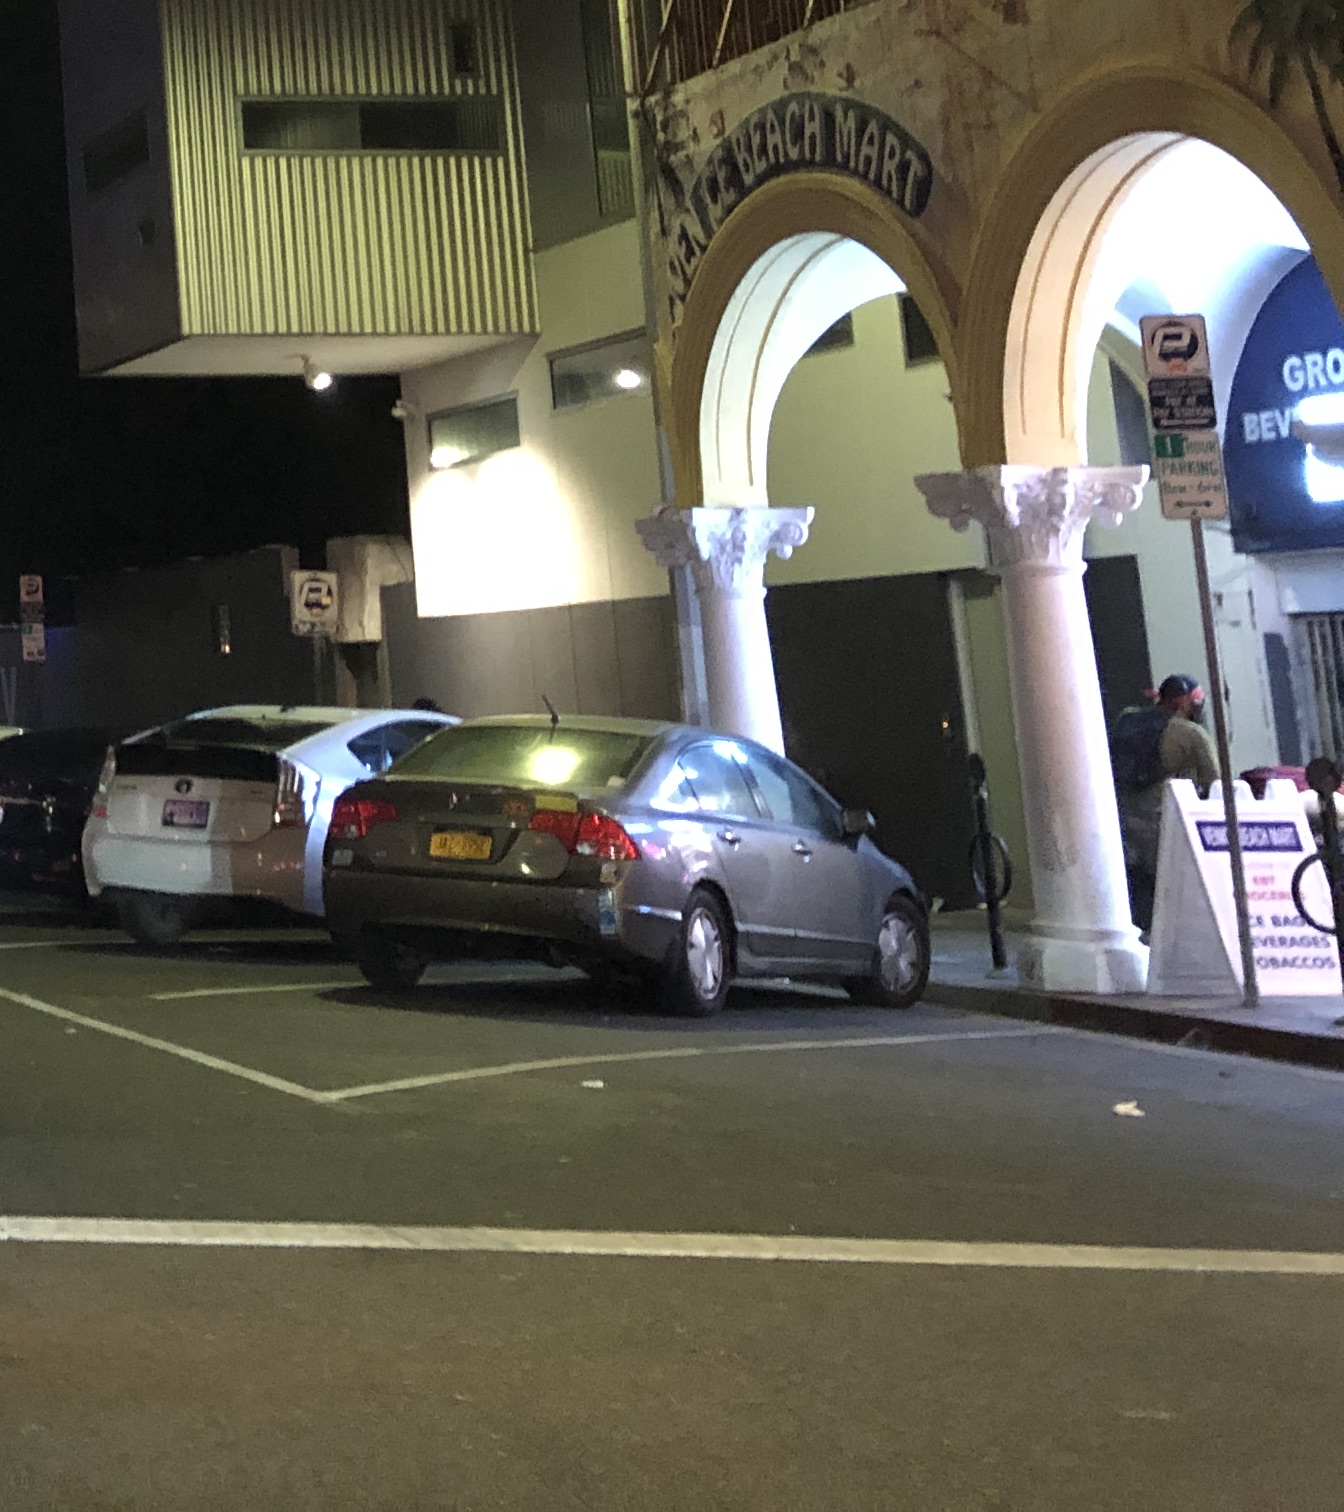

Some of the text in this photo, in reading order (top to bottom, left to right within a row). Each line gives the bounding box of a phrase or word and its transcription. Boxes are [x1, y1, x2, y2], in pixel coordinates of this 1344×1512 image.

[732, 99, 822, 187] BEACH
[834, 102, 924, 211] MART
[1161, 459, 1219, 477] PARKING
[1256, 955, 1336, 970] OBACCOS
